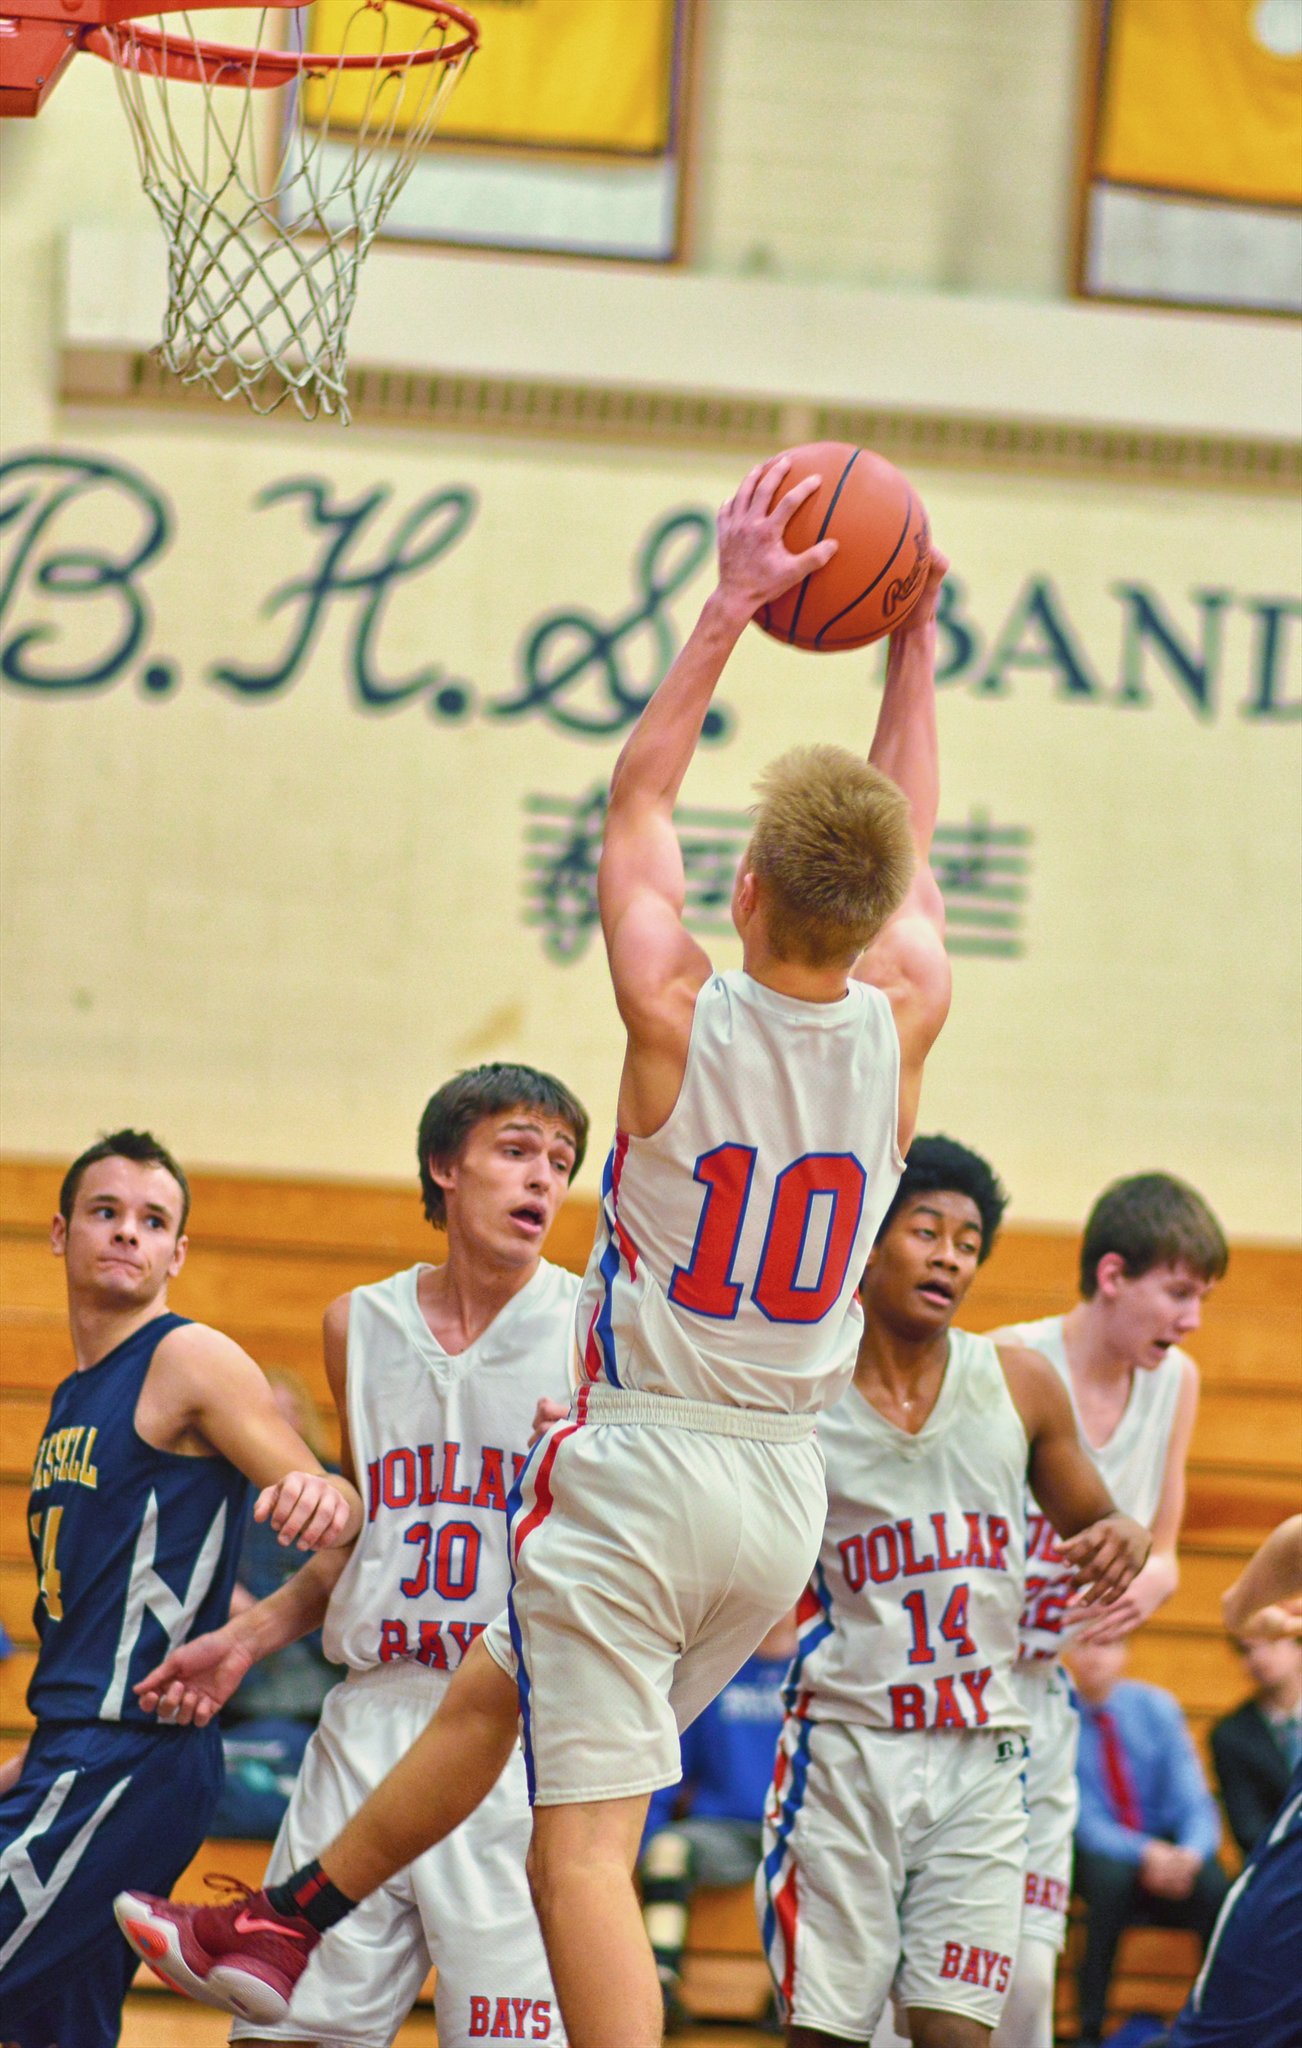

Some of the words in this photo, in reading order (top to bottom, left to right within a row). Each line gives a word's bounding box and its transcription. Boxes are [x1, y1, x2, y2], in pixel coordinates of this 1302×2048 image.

[667, 1141, 867, 1324] 10
[400, 1520, 482, 1602] 30
[837, 1511, 1010, 1594] DOLLAR
[902, 1582, 978, 1666] 14
[888, 1665, 993, 1730] BAY
[940, 1940, 1013, 1993] BAYS
[469, 1995, 552, 2040] BAYS
